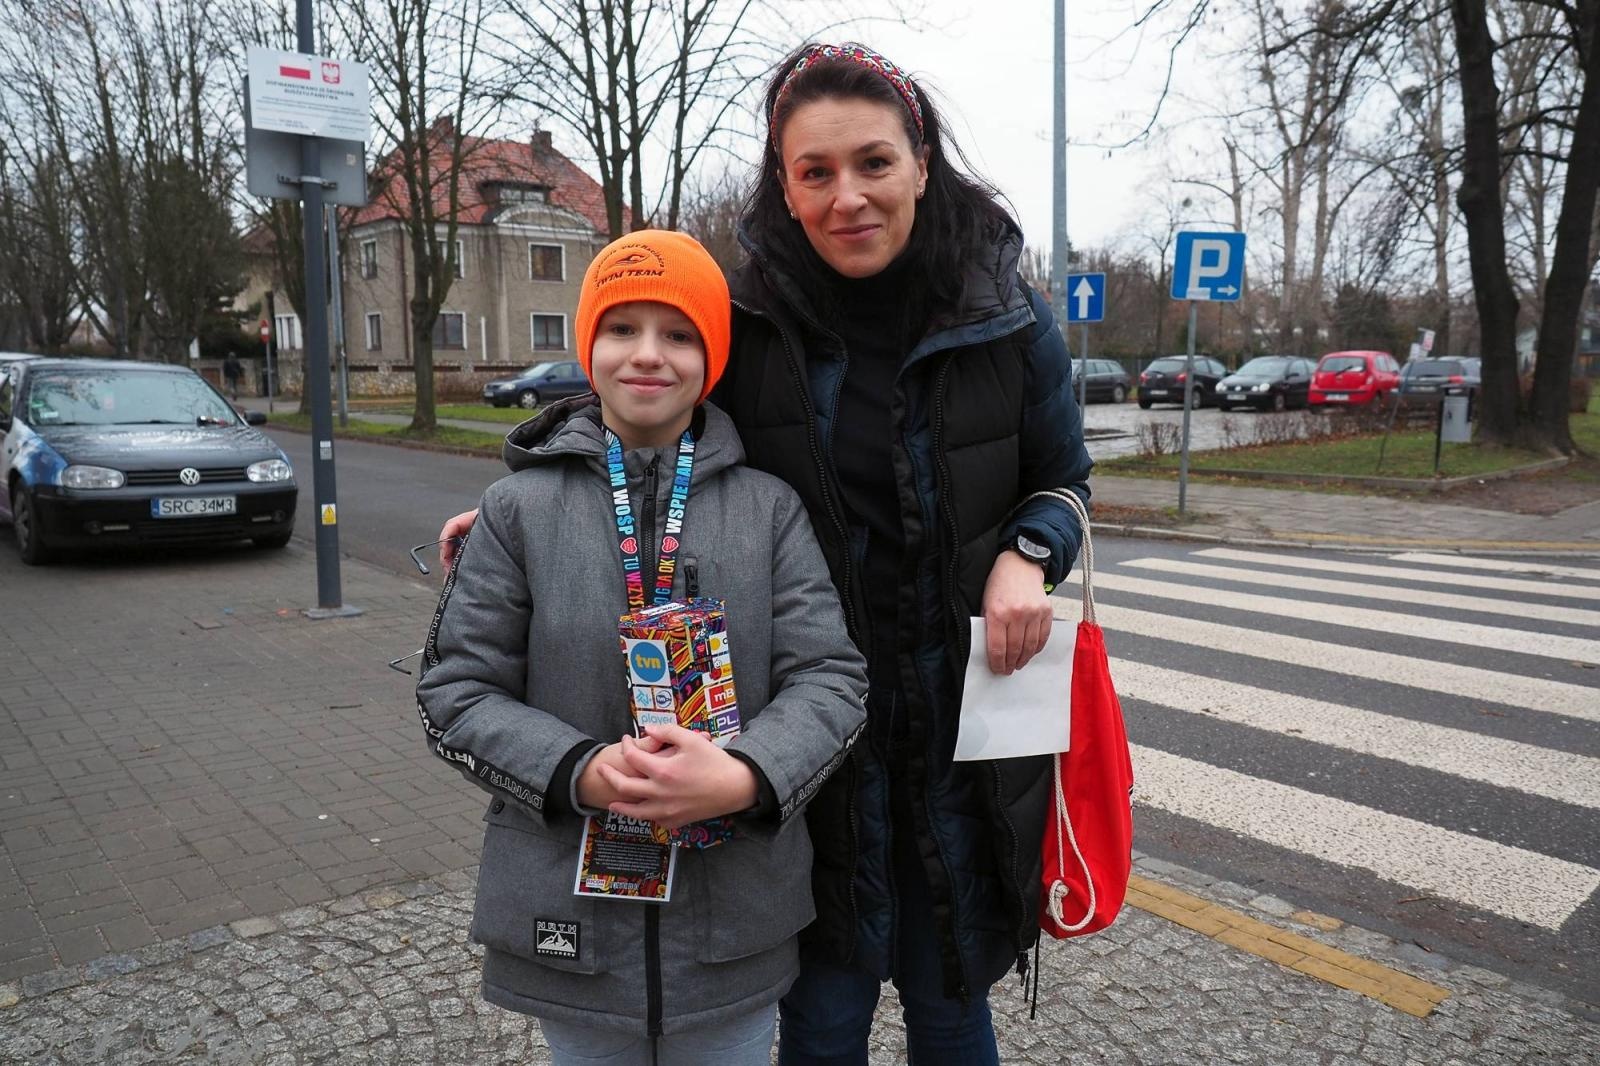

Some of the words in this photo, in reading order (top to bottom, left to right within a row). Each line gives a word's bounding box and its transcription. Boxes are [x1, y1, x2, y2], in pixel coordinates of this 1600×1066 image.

[1186, 239, 1231, 289] P
[626, 269, 665, 277] TEAM
[665, 455, 693, 533] WSPIERAM
[162, 500, 194, 514] SRC
[199, 498, 233, 512] 34M3
[612, 488, 635, 536] WOŚP
[623, 556, 640, 570] TU
[658, 555, 676, 574] OK!
[655, 575, 673, 595] GRA
[635, 653, 662, 669] tvn
[714, 688, 735, 703] mB
[640, 713, 673, 726] player
[605, 824, 617, 832] PO
[537, 921, 577, 933] NRTH
